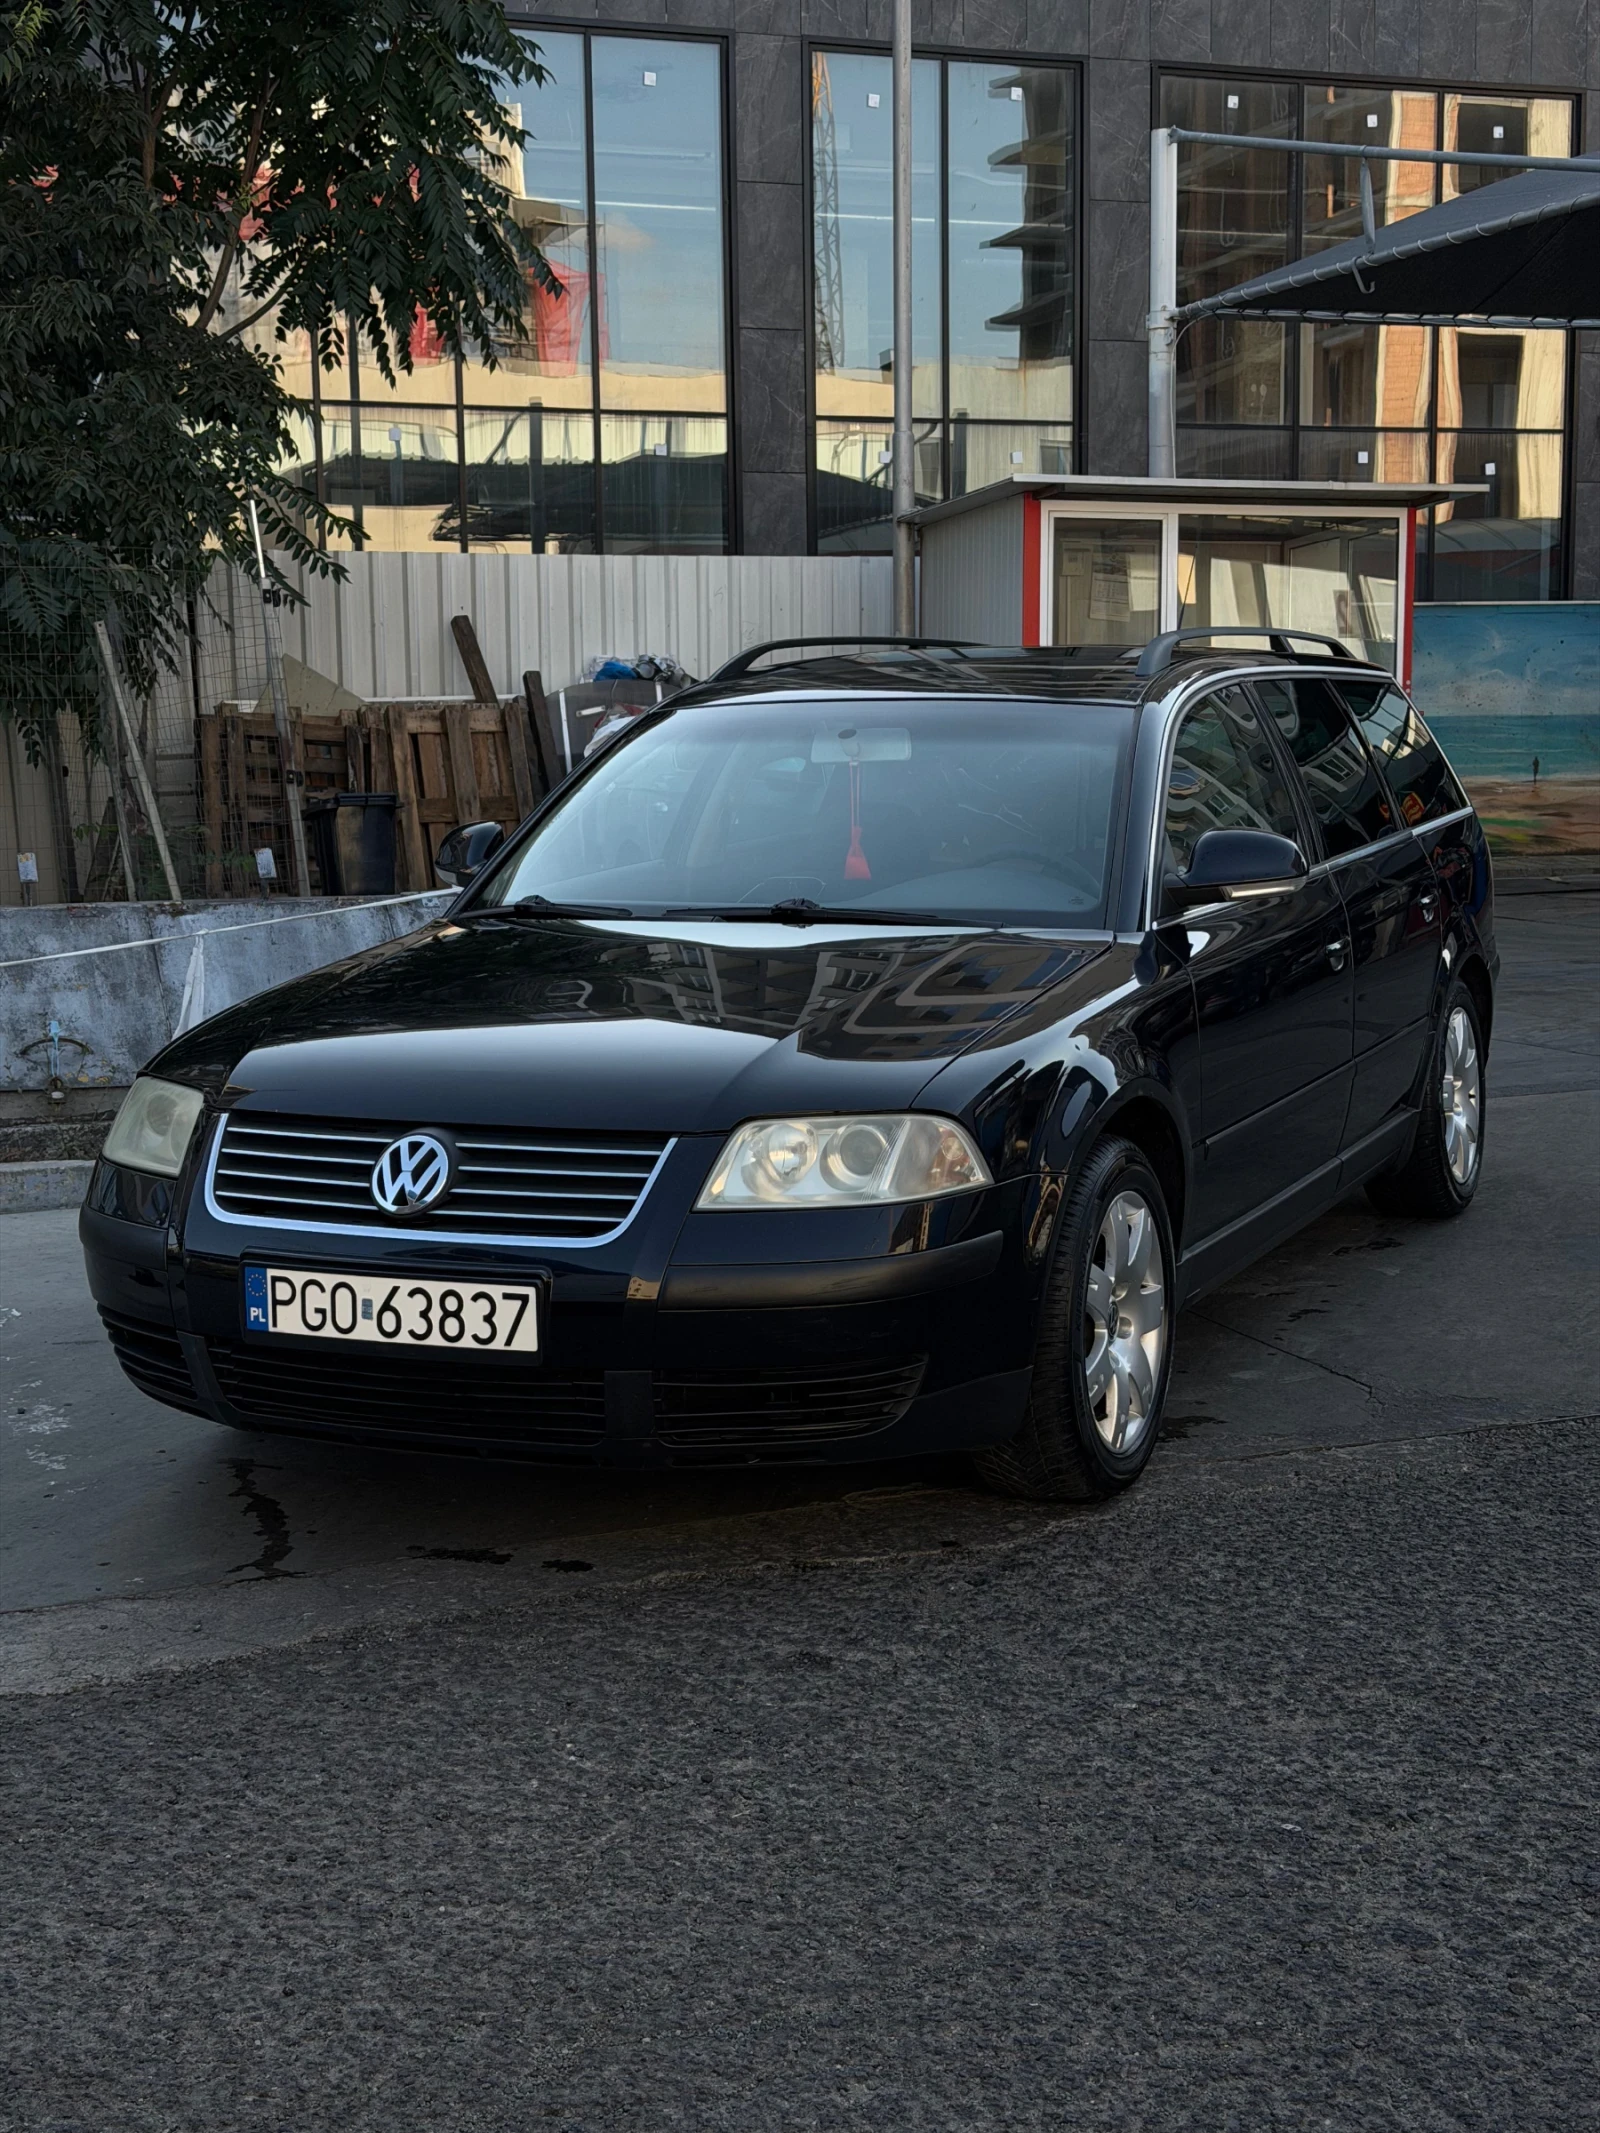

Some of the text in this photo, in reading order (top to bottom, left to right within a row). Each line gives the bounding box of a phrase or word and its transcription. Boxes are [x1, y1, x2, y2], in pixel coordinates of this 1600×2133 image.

[376, 1136, 445, 1210] VW
[250, 1306, 267, 1322] PL
[270, 1275, 530, 1347] PGO 63837
